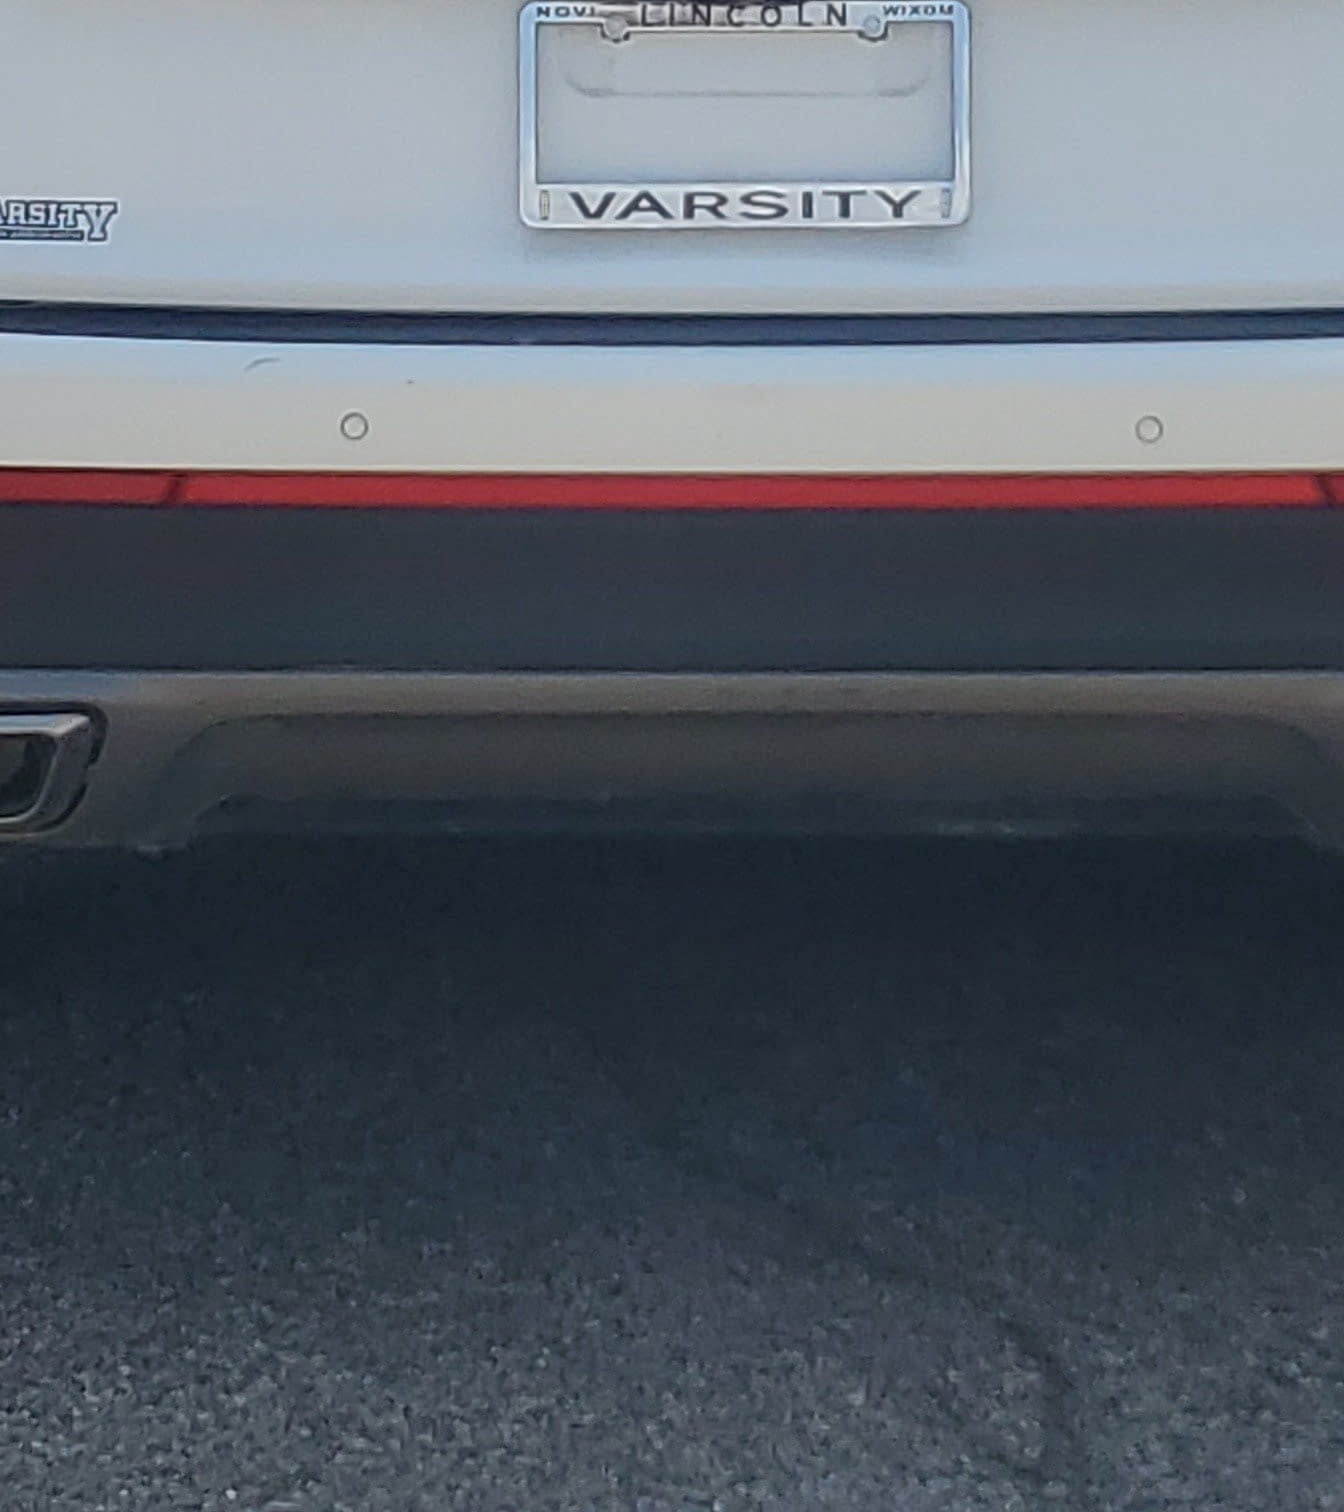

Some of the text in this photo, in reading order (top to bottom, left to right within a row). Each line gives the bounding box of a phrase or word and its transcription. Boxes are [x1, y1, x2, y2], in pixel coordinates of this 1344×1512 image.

[536, 2, 955, 27] NOVI LINCOLN WIXOM
[569, 190, 922, 220] VARSITY
